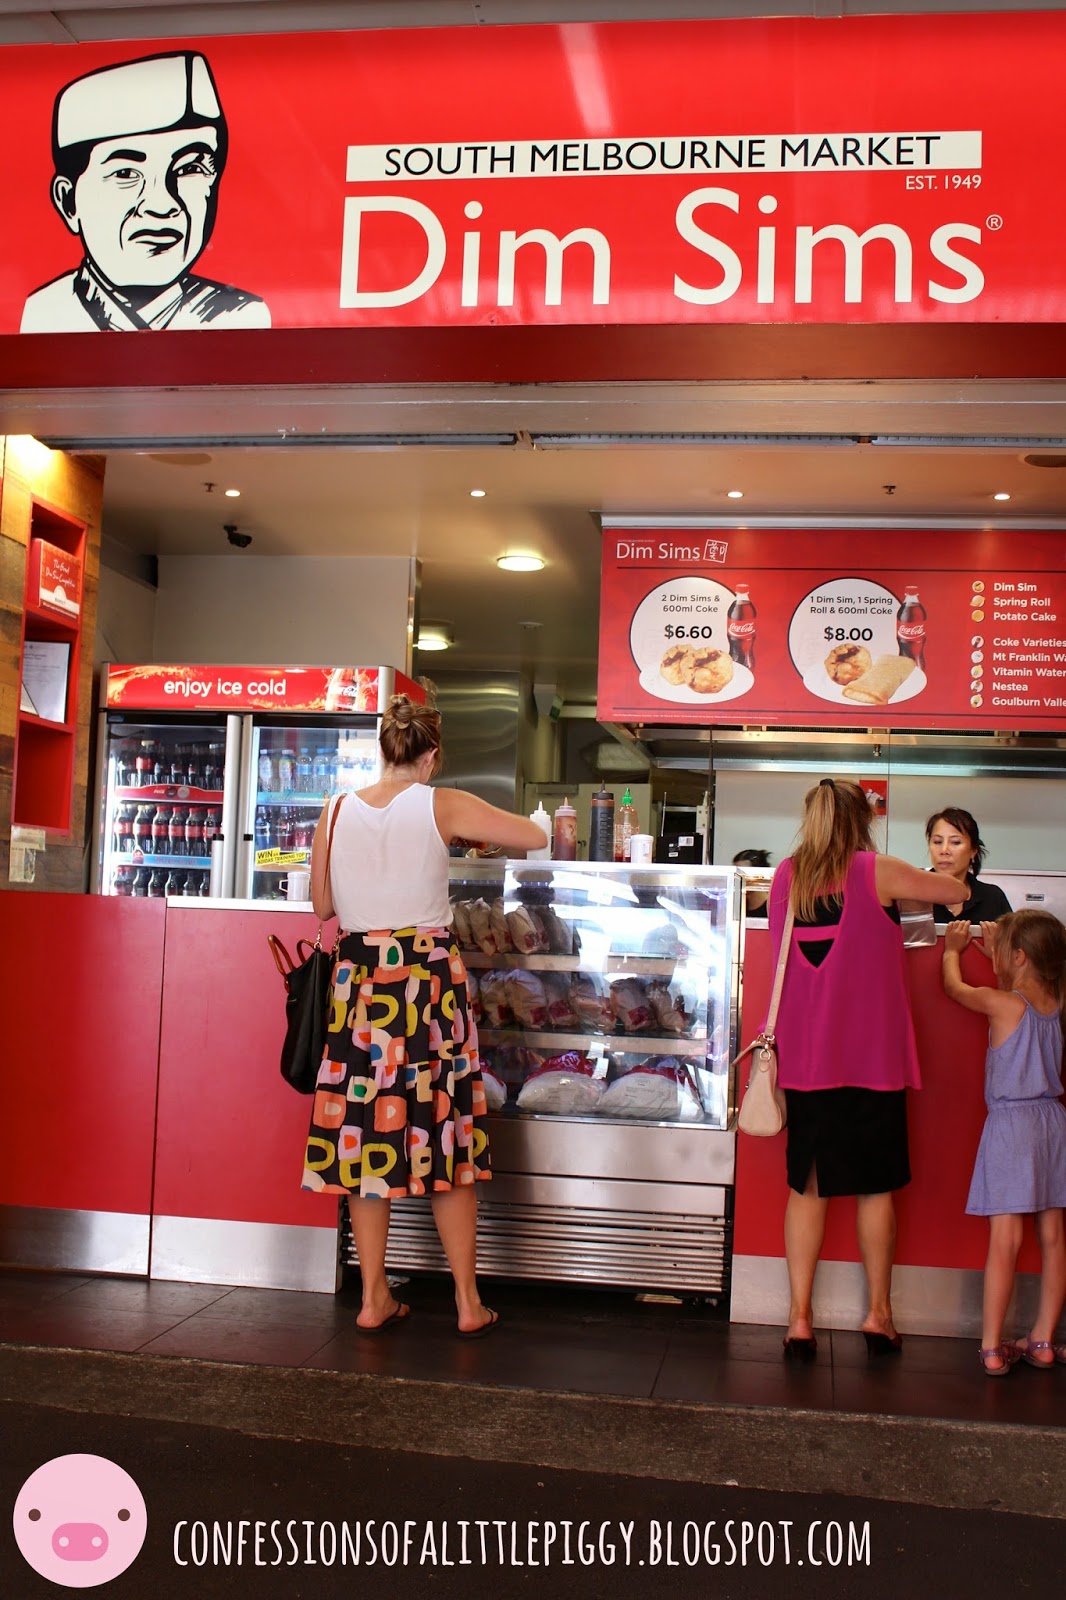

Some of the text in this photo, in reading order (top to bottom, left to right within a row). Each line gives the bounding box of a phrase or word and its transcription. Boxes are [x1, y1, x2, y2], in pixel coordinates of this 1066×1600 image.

[384, 136, 941, 177] SOUTH MELBOURNE MARKET
[905, 174, 982, 191] EST. 1949
[339, 195, 611, 310] Dim
[616, 542, 653, 559] Dim
[658, 542, 700, 559] Sims
[993, 583, 1037, 592] Dim Sim
[661, 594, 667, 602] 2
[669, 594, 688, 602] Dim
[690, 594, 712, 602] Sims
[836, 596, 855, 605] Sim,
[864, 596, 893, 606] Spring
[993, 597, 1051, 608] Spring Roll
[662, 604, 718, 613] 600ml Coke
[810, 606, 827, 614] Roll
[838, 607, 868, 615] 600ml
[870, 607, 893, 615] Coke
[993, 612, 1057, 621] Potato Cake
[664, 623, 713, 640] $6.60
[824, 626, 873, 642] $8.00
[993, 638, 1066, 647] Coke Varieties
[993, 652, 1007, 661] Mt
[1008, 653, 1051, 662] Franklin
[992, 667, 1066, 677] Vitamin Water
[163, 679, 286, 698] enjoy ice cold
[992, 682, 1029, 691] Nestea
[992, 697, 1040, 706] Goulburn
[257, 850, 273, 859] WIN
